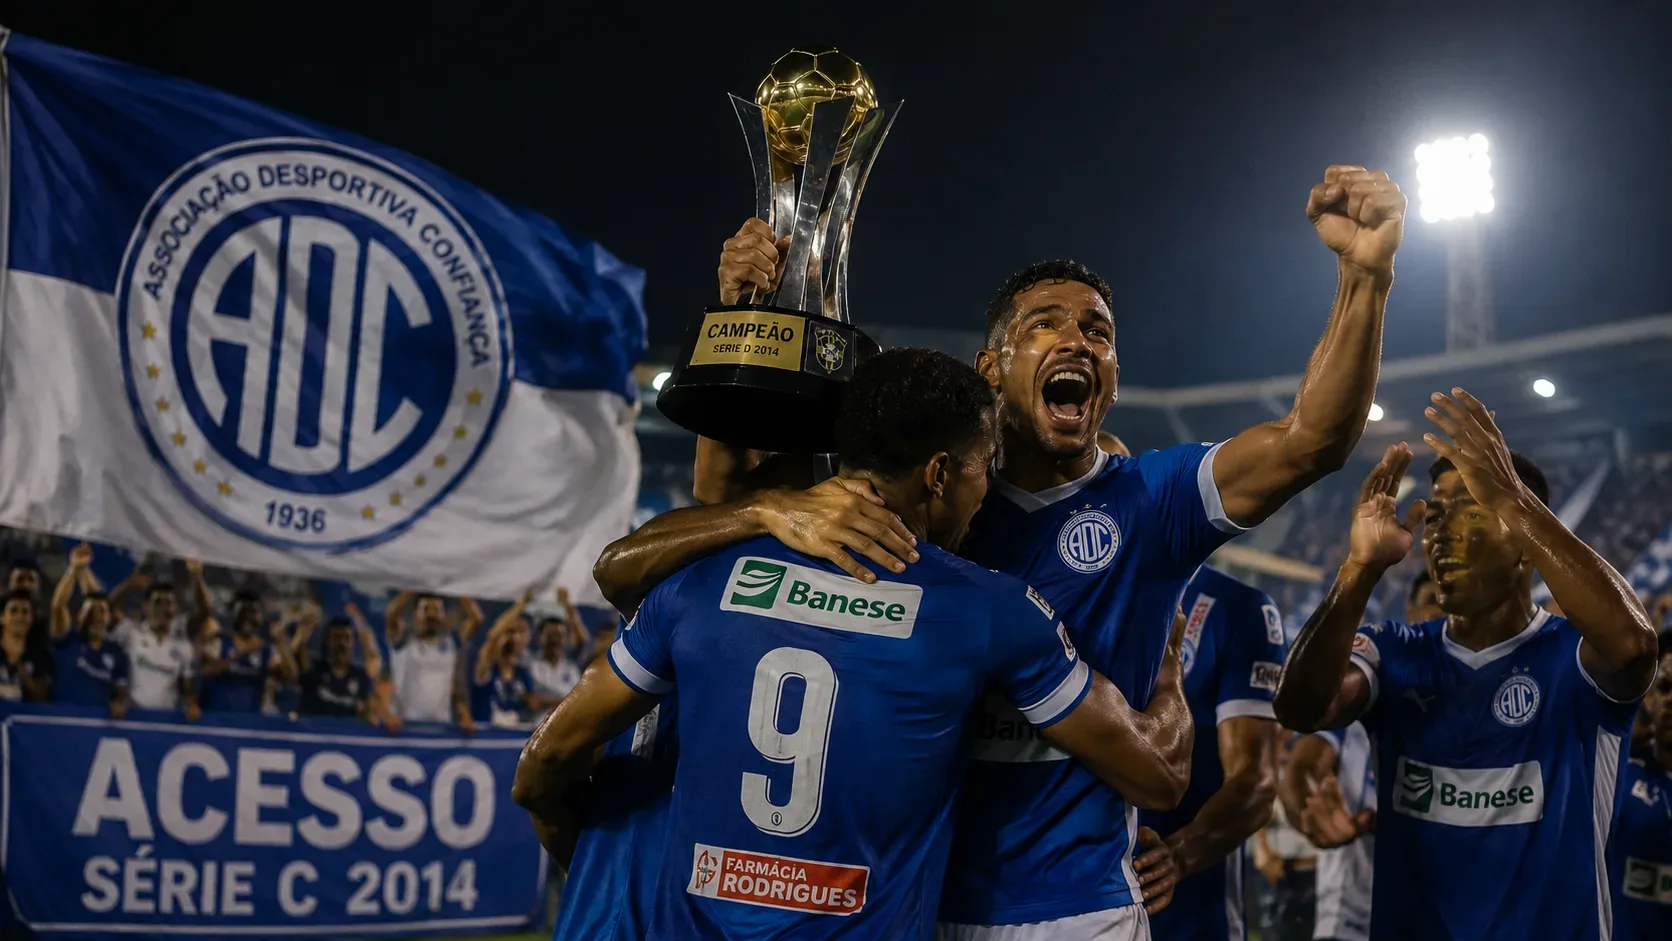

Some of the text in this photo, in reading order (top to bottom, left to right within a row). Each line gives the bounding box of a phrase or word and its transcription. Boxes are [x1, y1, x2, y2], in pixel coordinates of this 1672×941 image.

[143, 164, 491, 367] ASSOCIAÇÃO DESPORTIVA CONFIANÇA
[187, 215, 433, 475] ADC
[707, 321, 794, 342] CAMPEÃO
[713, 344, 779, 356] SERIE D 2014
[265, 500, 326, 533] 1936
[1069, 522, 1109, 562] ADC
[786, 580, 906, 622] Banese
[1501, 683, 1532, 718] ADC
[741, 646, 839, 838] 9
[982, 713, 1042, 740] Ban
[72, 737, 496, 850] ACESSO
[1440, 782, 1534, 809] Banese
[81, 845, 479, 917] SÉRIE C 2014
[722, 873, 857, 908] RODRIGUES
